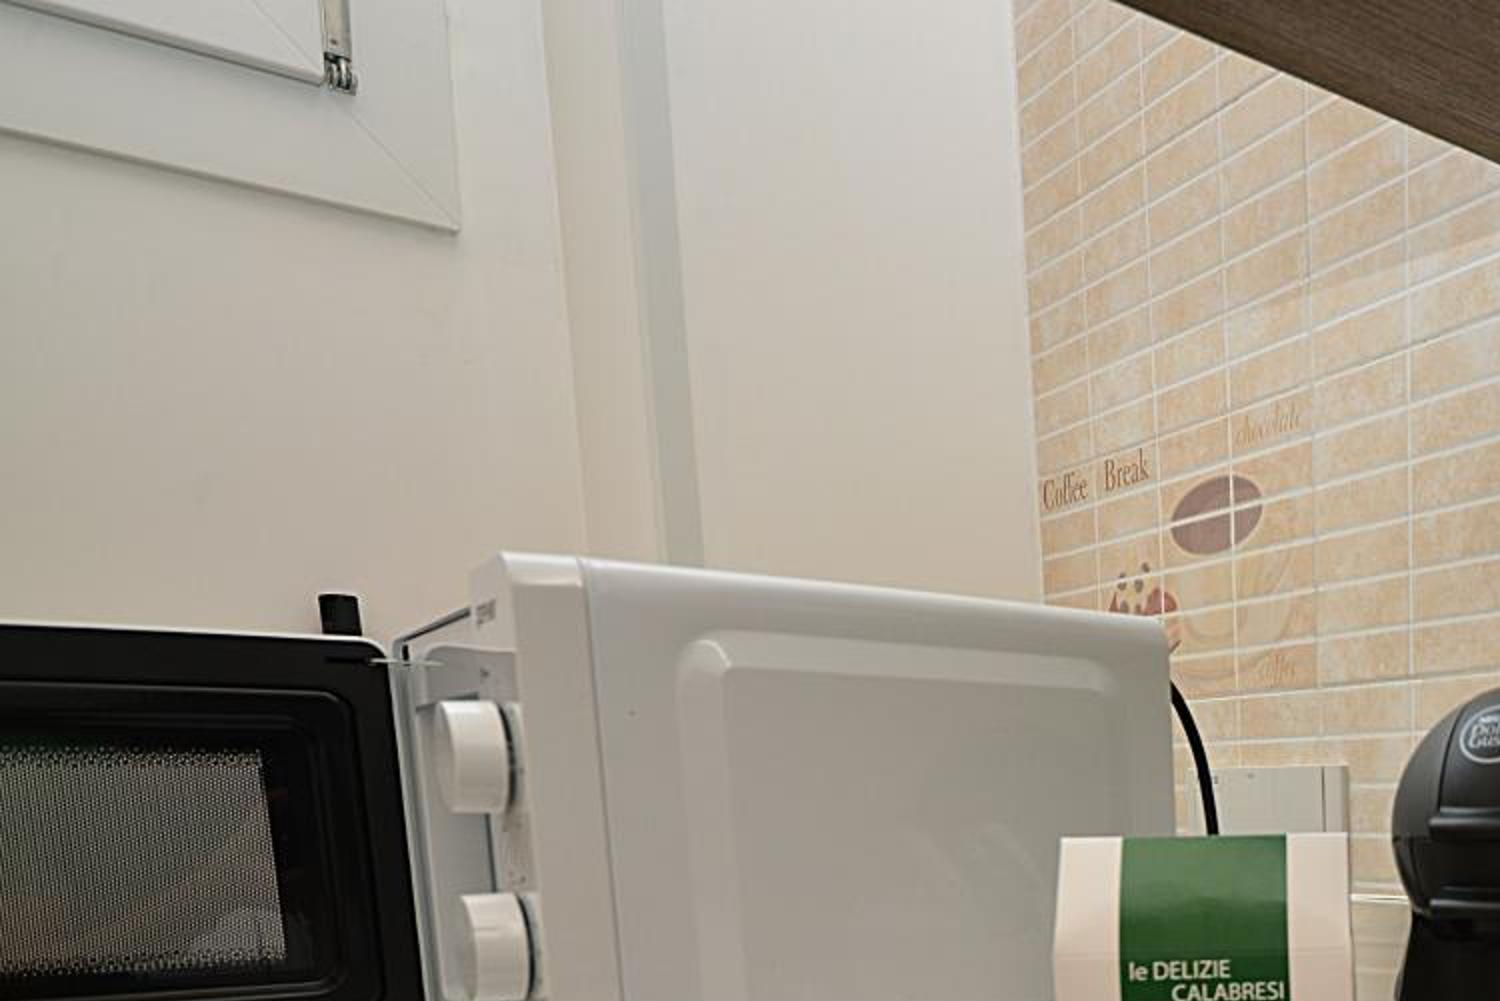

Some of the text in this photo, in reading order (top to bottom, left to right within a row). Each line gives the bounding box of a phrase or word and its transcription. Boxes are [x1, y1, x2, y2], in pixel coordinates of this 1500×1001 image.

[1042, 447, 1150, 511] Coffee Break
[1128, 959, 1232, 982] le DELIZIE
